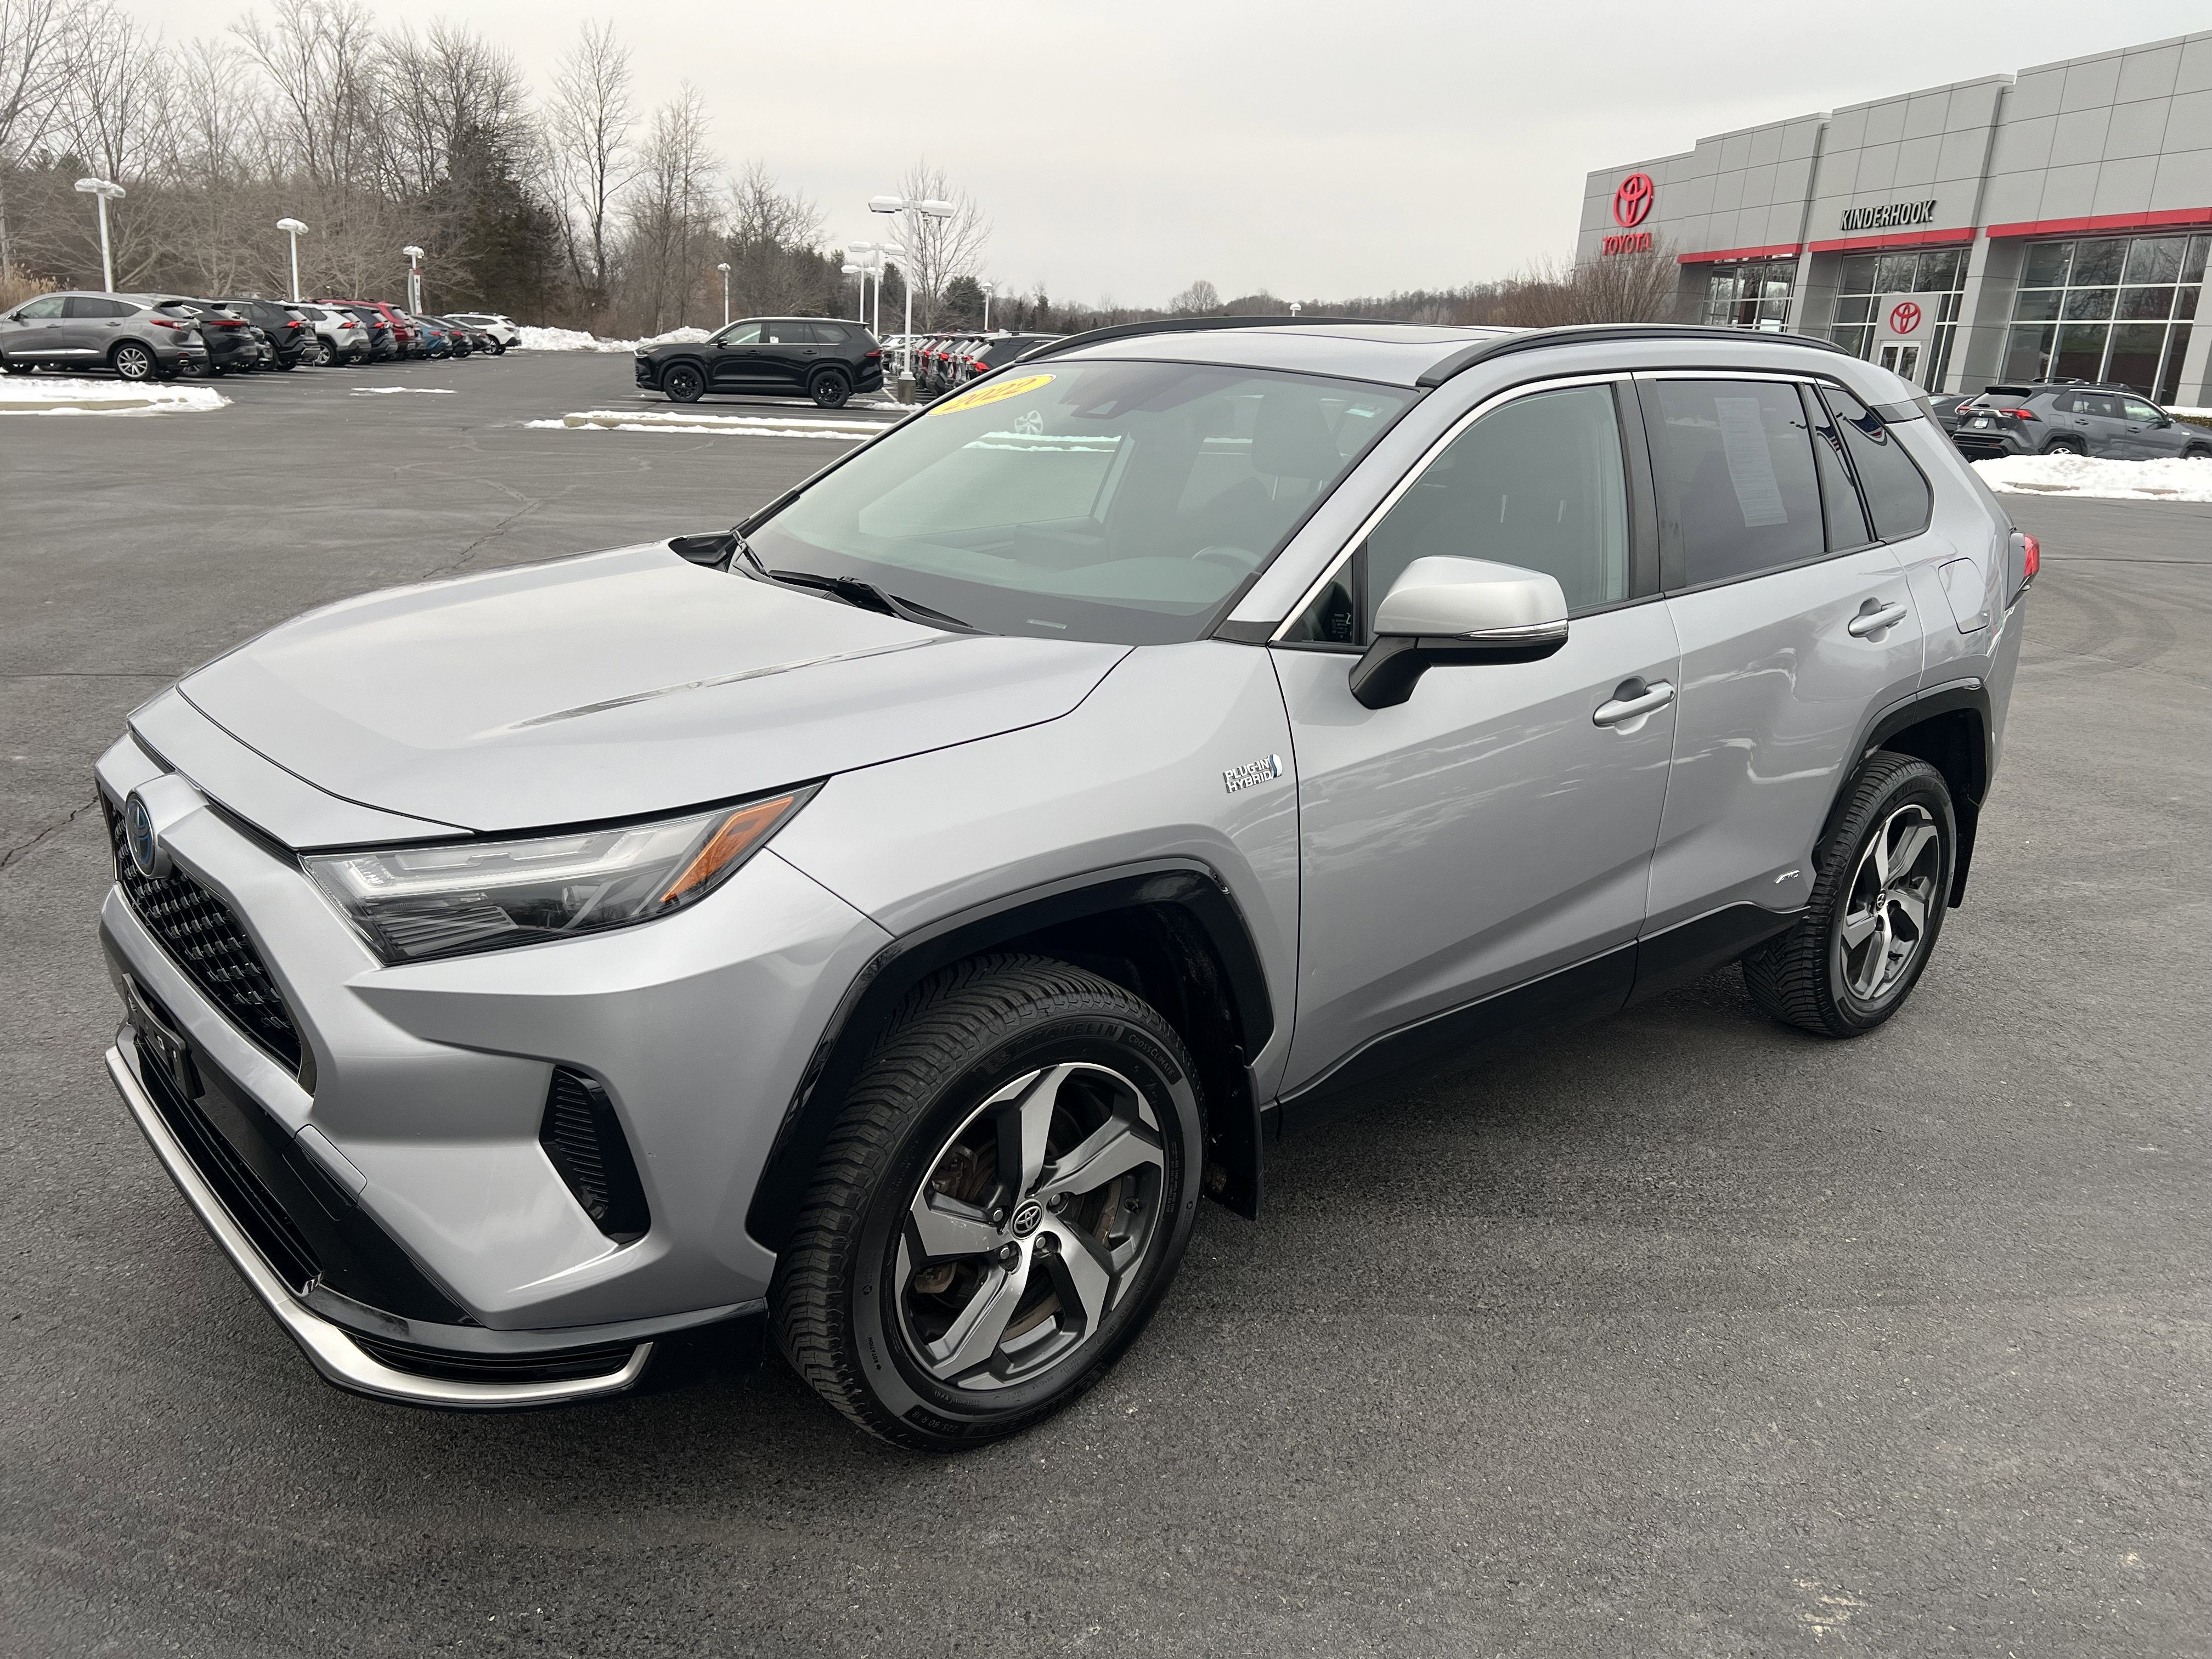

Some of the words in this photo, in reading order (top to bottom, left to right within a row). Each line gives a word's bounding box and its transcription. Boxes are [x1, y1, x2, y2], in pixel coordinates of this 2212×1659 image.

[1839, 200, 1936, 230] KINDERHOOK
[1602, 232, 1651, 256] TOYOTA
[941, 378, 1037, 411] 2022
[1223, 758, 1270, 782] PLUG-IN
[1226, 770, 1272, 793] HYBRID
[868, 1336, 879, 1363] ROTATION
